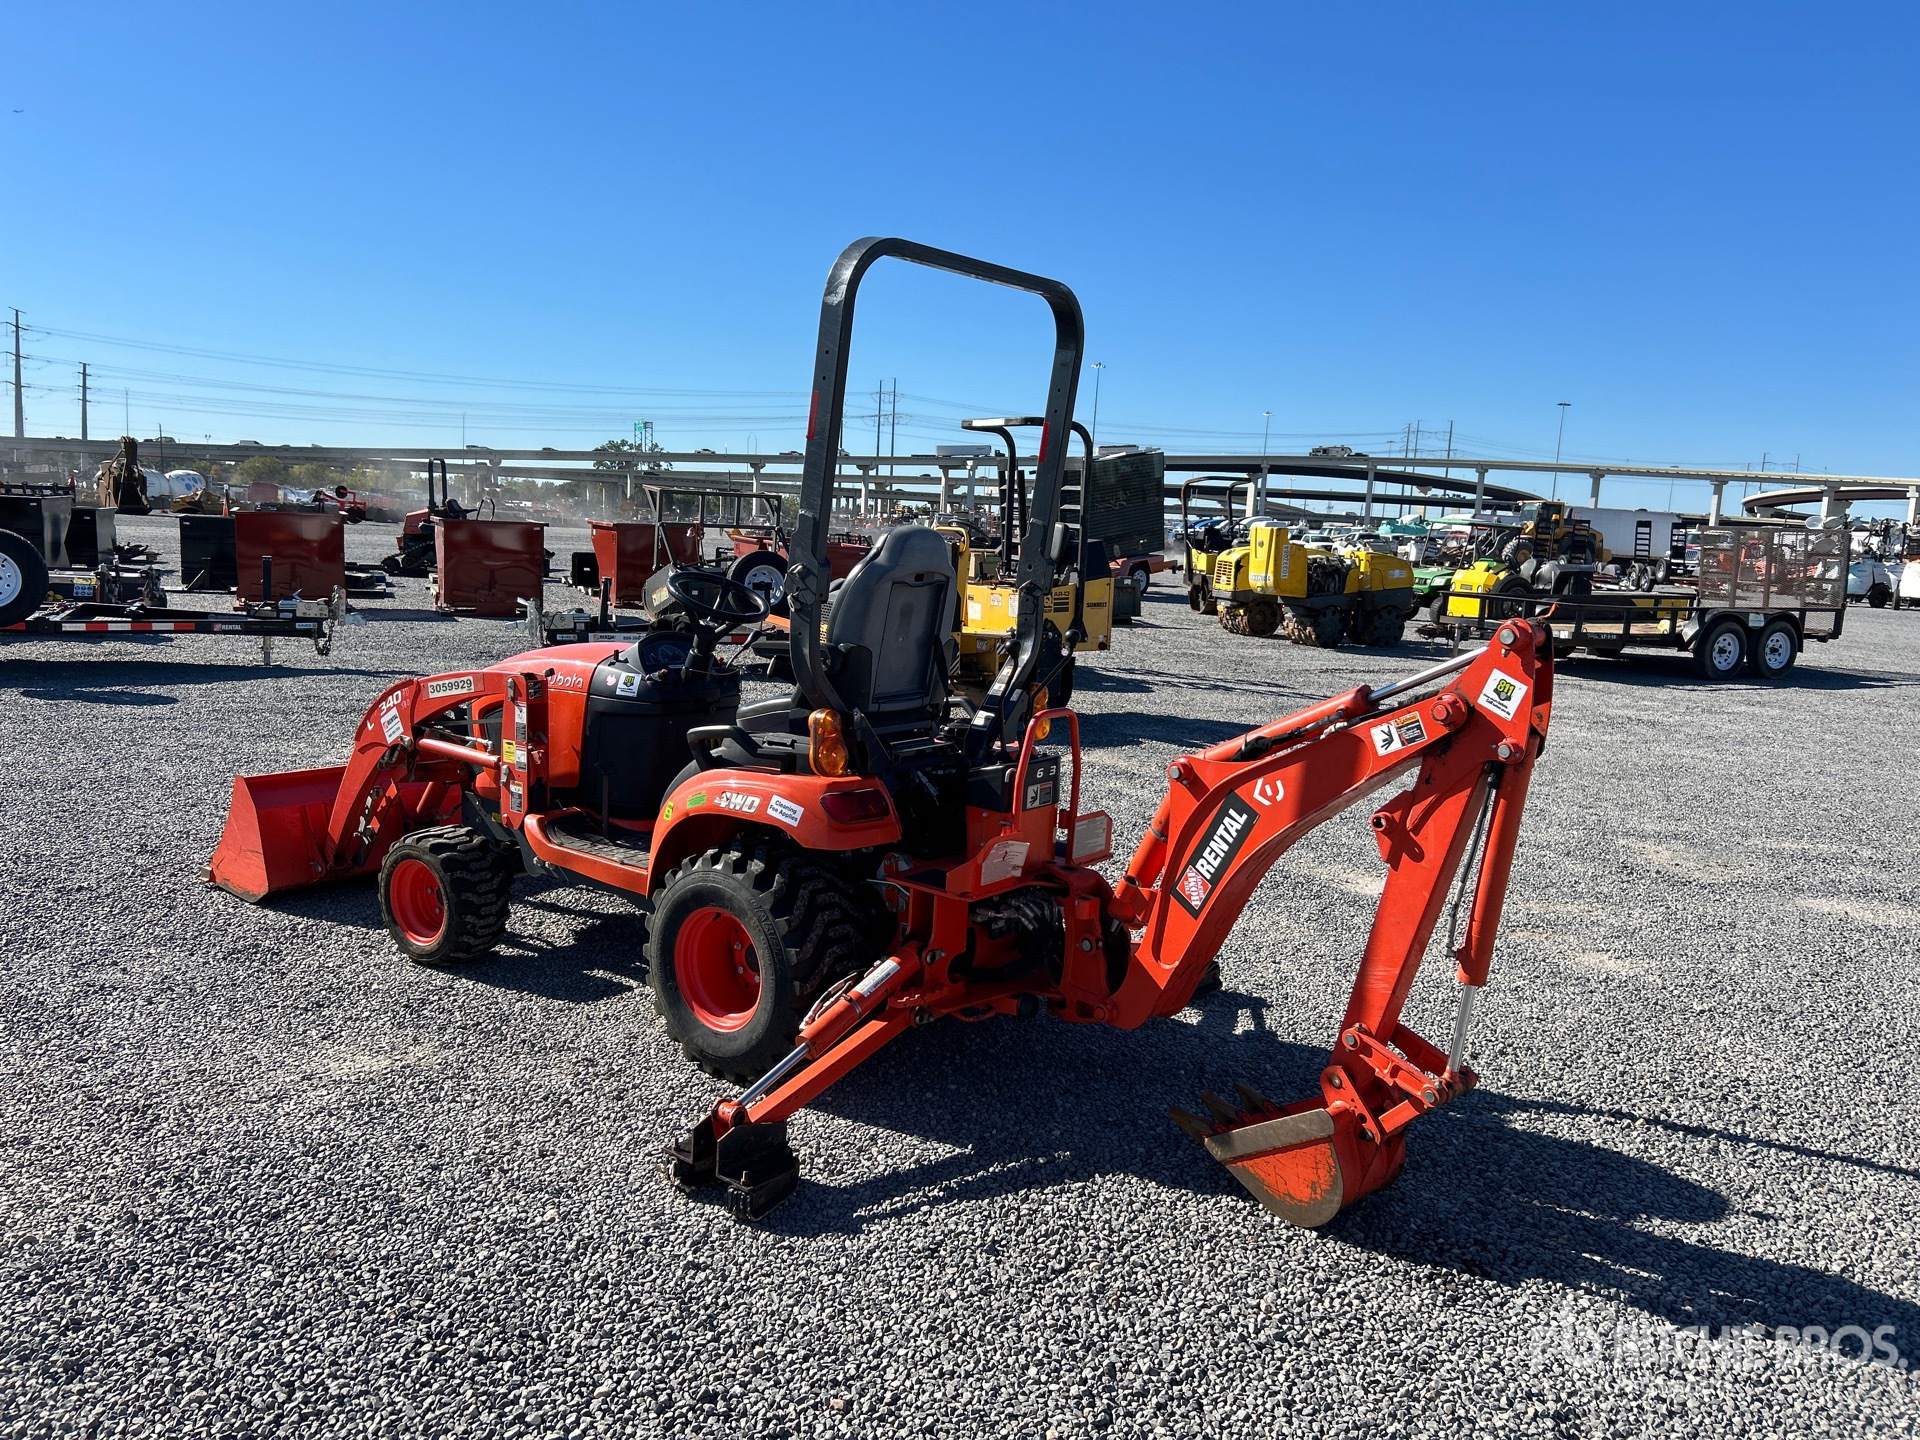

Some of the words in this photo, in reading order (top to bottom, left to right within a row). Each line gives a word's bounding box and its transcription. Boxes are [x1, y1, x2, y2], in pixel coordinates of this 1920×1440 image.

[429, 678, 472, 694] 3059929
[548, 671, 583, 689] ubota
[1496, 679, 1516, 696] 811
[378, 690, 402, 716] 340
[713, 790, 762, 813] 4WD
[774, 799, 798, 815] Cleaning
[768, 804, 779, 814] Fee
[778, 808, 798, 822] Applies
[1196, 807, 1248, 880] RENTAL
[1186, 870, 1201, 908] HOME
